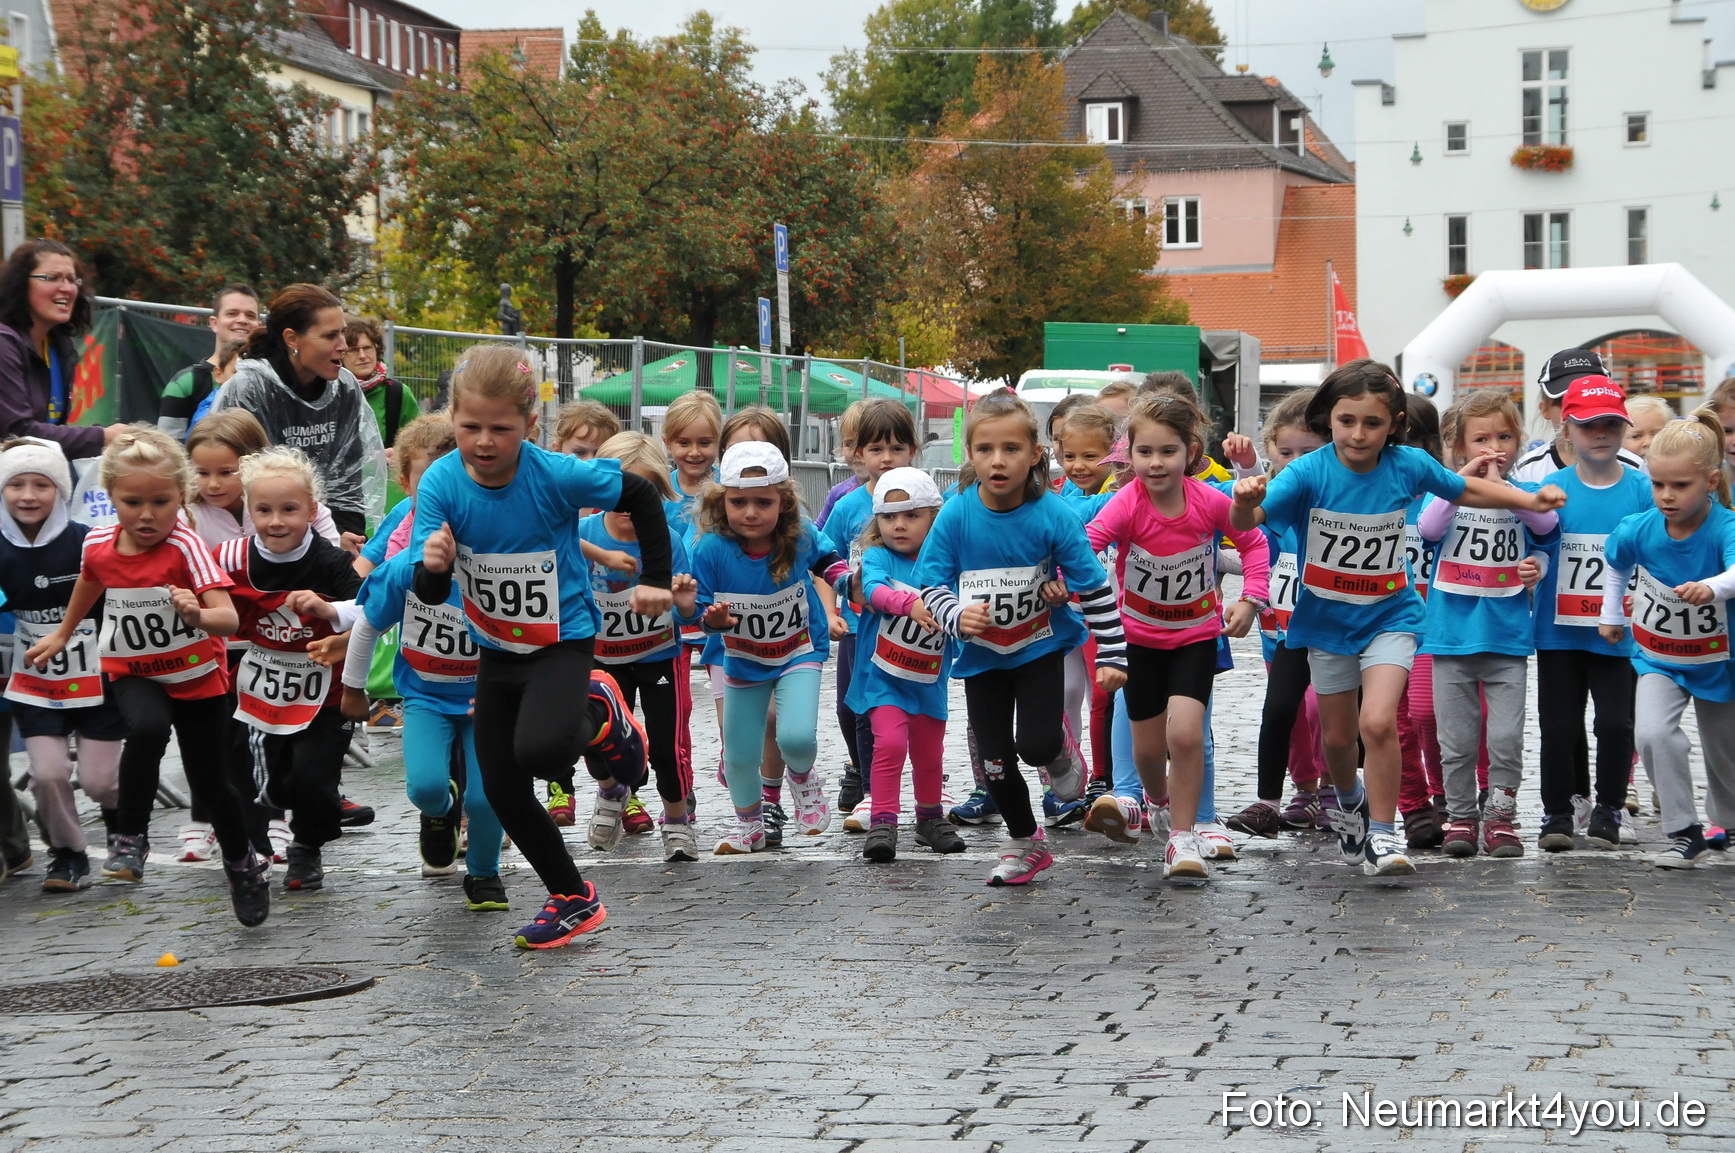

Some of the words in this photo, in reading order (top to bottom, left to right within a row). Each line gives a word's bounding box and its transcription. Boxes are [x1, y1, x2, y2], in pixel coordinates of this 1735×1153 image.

[3, 127, 17, 190] P
[778, 231, 785, 264] P
[761, 305, 768, 339] P
[1311, 516, 1346, 530] PARTL
[1349, 522, 1395, 533] Neumarkt
[1454, 511, 1477, 522] PARTL
[1479, 514, 1515, 524] Neumarkt
[1319, 531, 1400, 570] 7227
[1452, 525, 1518, 562] 7588
[1561, 543, 1588, 551] PARTL
[1592, 544, 1605, 552] Ne
[478, 564, 536, 574] Neumarkt
[1129, 550, 1158, 570] PARTL
[1161, 553, 1203, 571] Neumarkt
[962, 579, 997, 589] PARTL
[1000, 571, 1041, 587] Neumarkt
[1134, 562, 1206, 601] 7121
[1451, 565, 1481, 582] Julia
[460, 565, 548, 618] 7595
[1333, 575, 1378, 592] Emilia
[1639, 575, 1659, 597] PARTL
[122, 597, 174, 609] Neumarkt
[406, 600, 439, 618] PARTL
[751, 595, 794, 610] Neumarkt
[730, 602, 803, 640] 7024
[1148, 604, 1194, 620] Sophie
[1642, 592, 1718, 636] 7213
[108, 613, 196, 652] 7084
[255, 625, 314, 643] adidas
[736, 638, 800, 656] Magdalena
[1650, 637, 1702, 654] Carlotta
[127, 656, 186, 675] Madlen
[269, 656, 316, 669] Neumarkt
[247, 661, 323, 702] 7550
